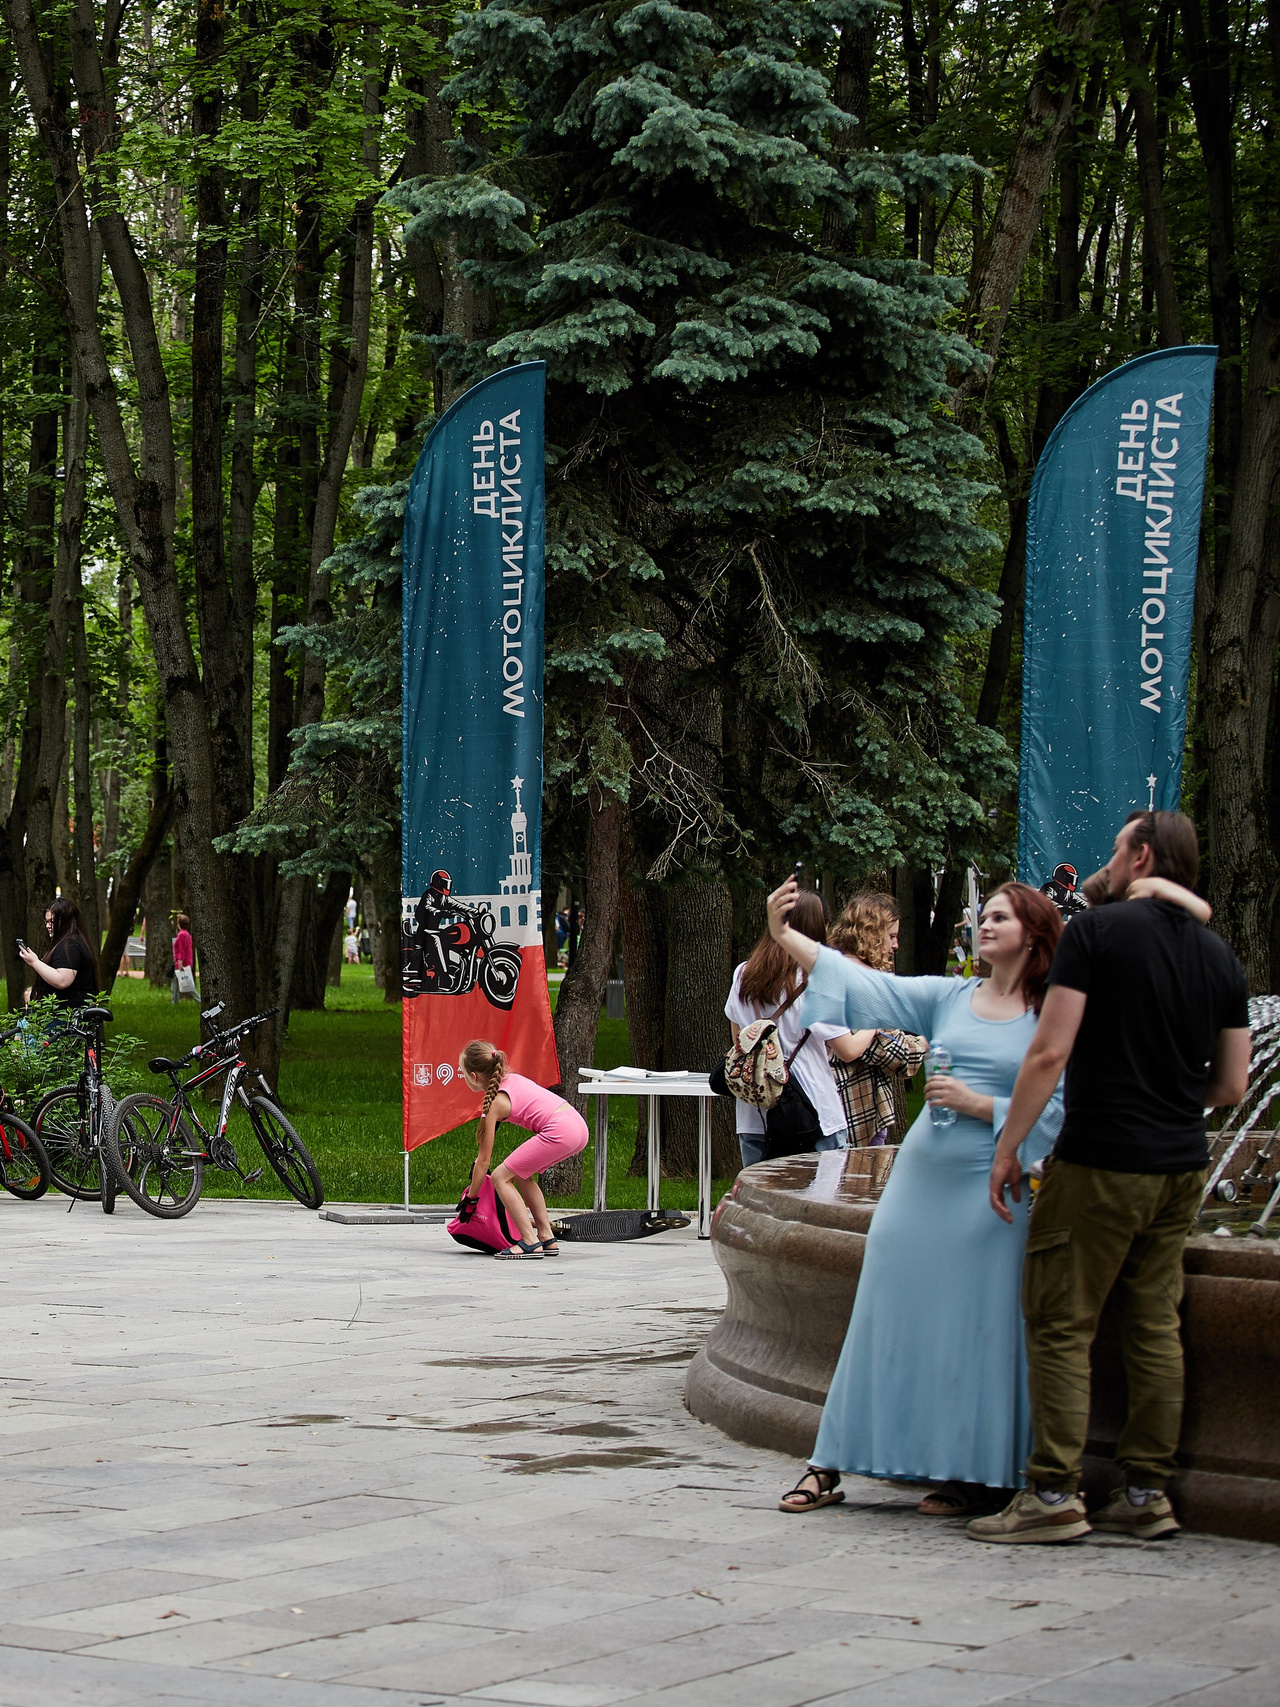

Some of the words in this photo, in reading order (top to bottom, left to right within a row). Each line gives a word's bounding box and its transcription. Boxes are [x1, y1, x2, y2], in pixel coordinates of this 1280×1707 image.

[473, 420, 500, 518] ДЕНЬ
[1116, 399, 1148, 501] ДЕНЬ
[1140, 392, 1183, 714] МОТОЦИКЛИСТА
[499, 408, 525, 718] МОТОЦИКЛИСТА
